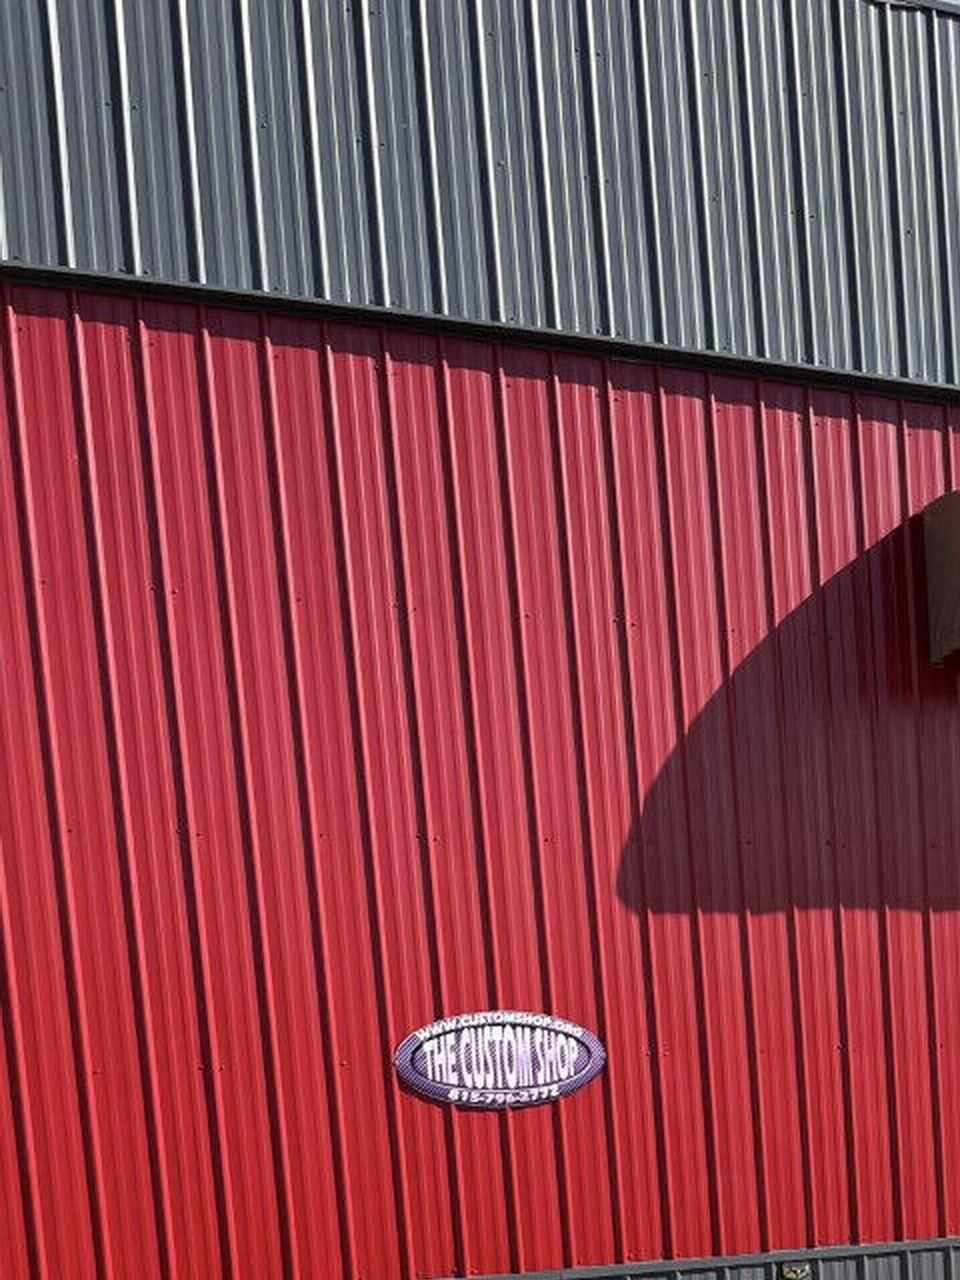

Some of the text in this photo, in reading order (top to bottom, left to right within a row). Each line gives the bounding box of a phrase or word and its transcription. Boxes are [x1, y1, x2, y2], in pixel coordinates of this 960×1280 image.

[423, 1024, 579, 1089] THE CUSTOM SHOP
[448, 1086, 561, 1104] 815-796-2772
